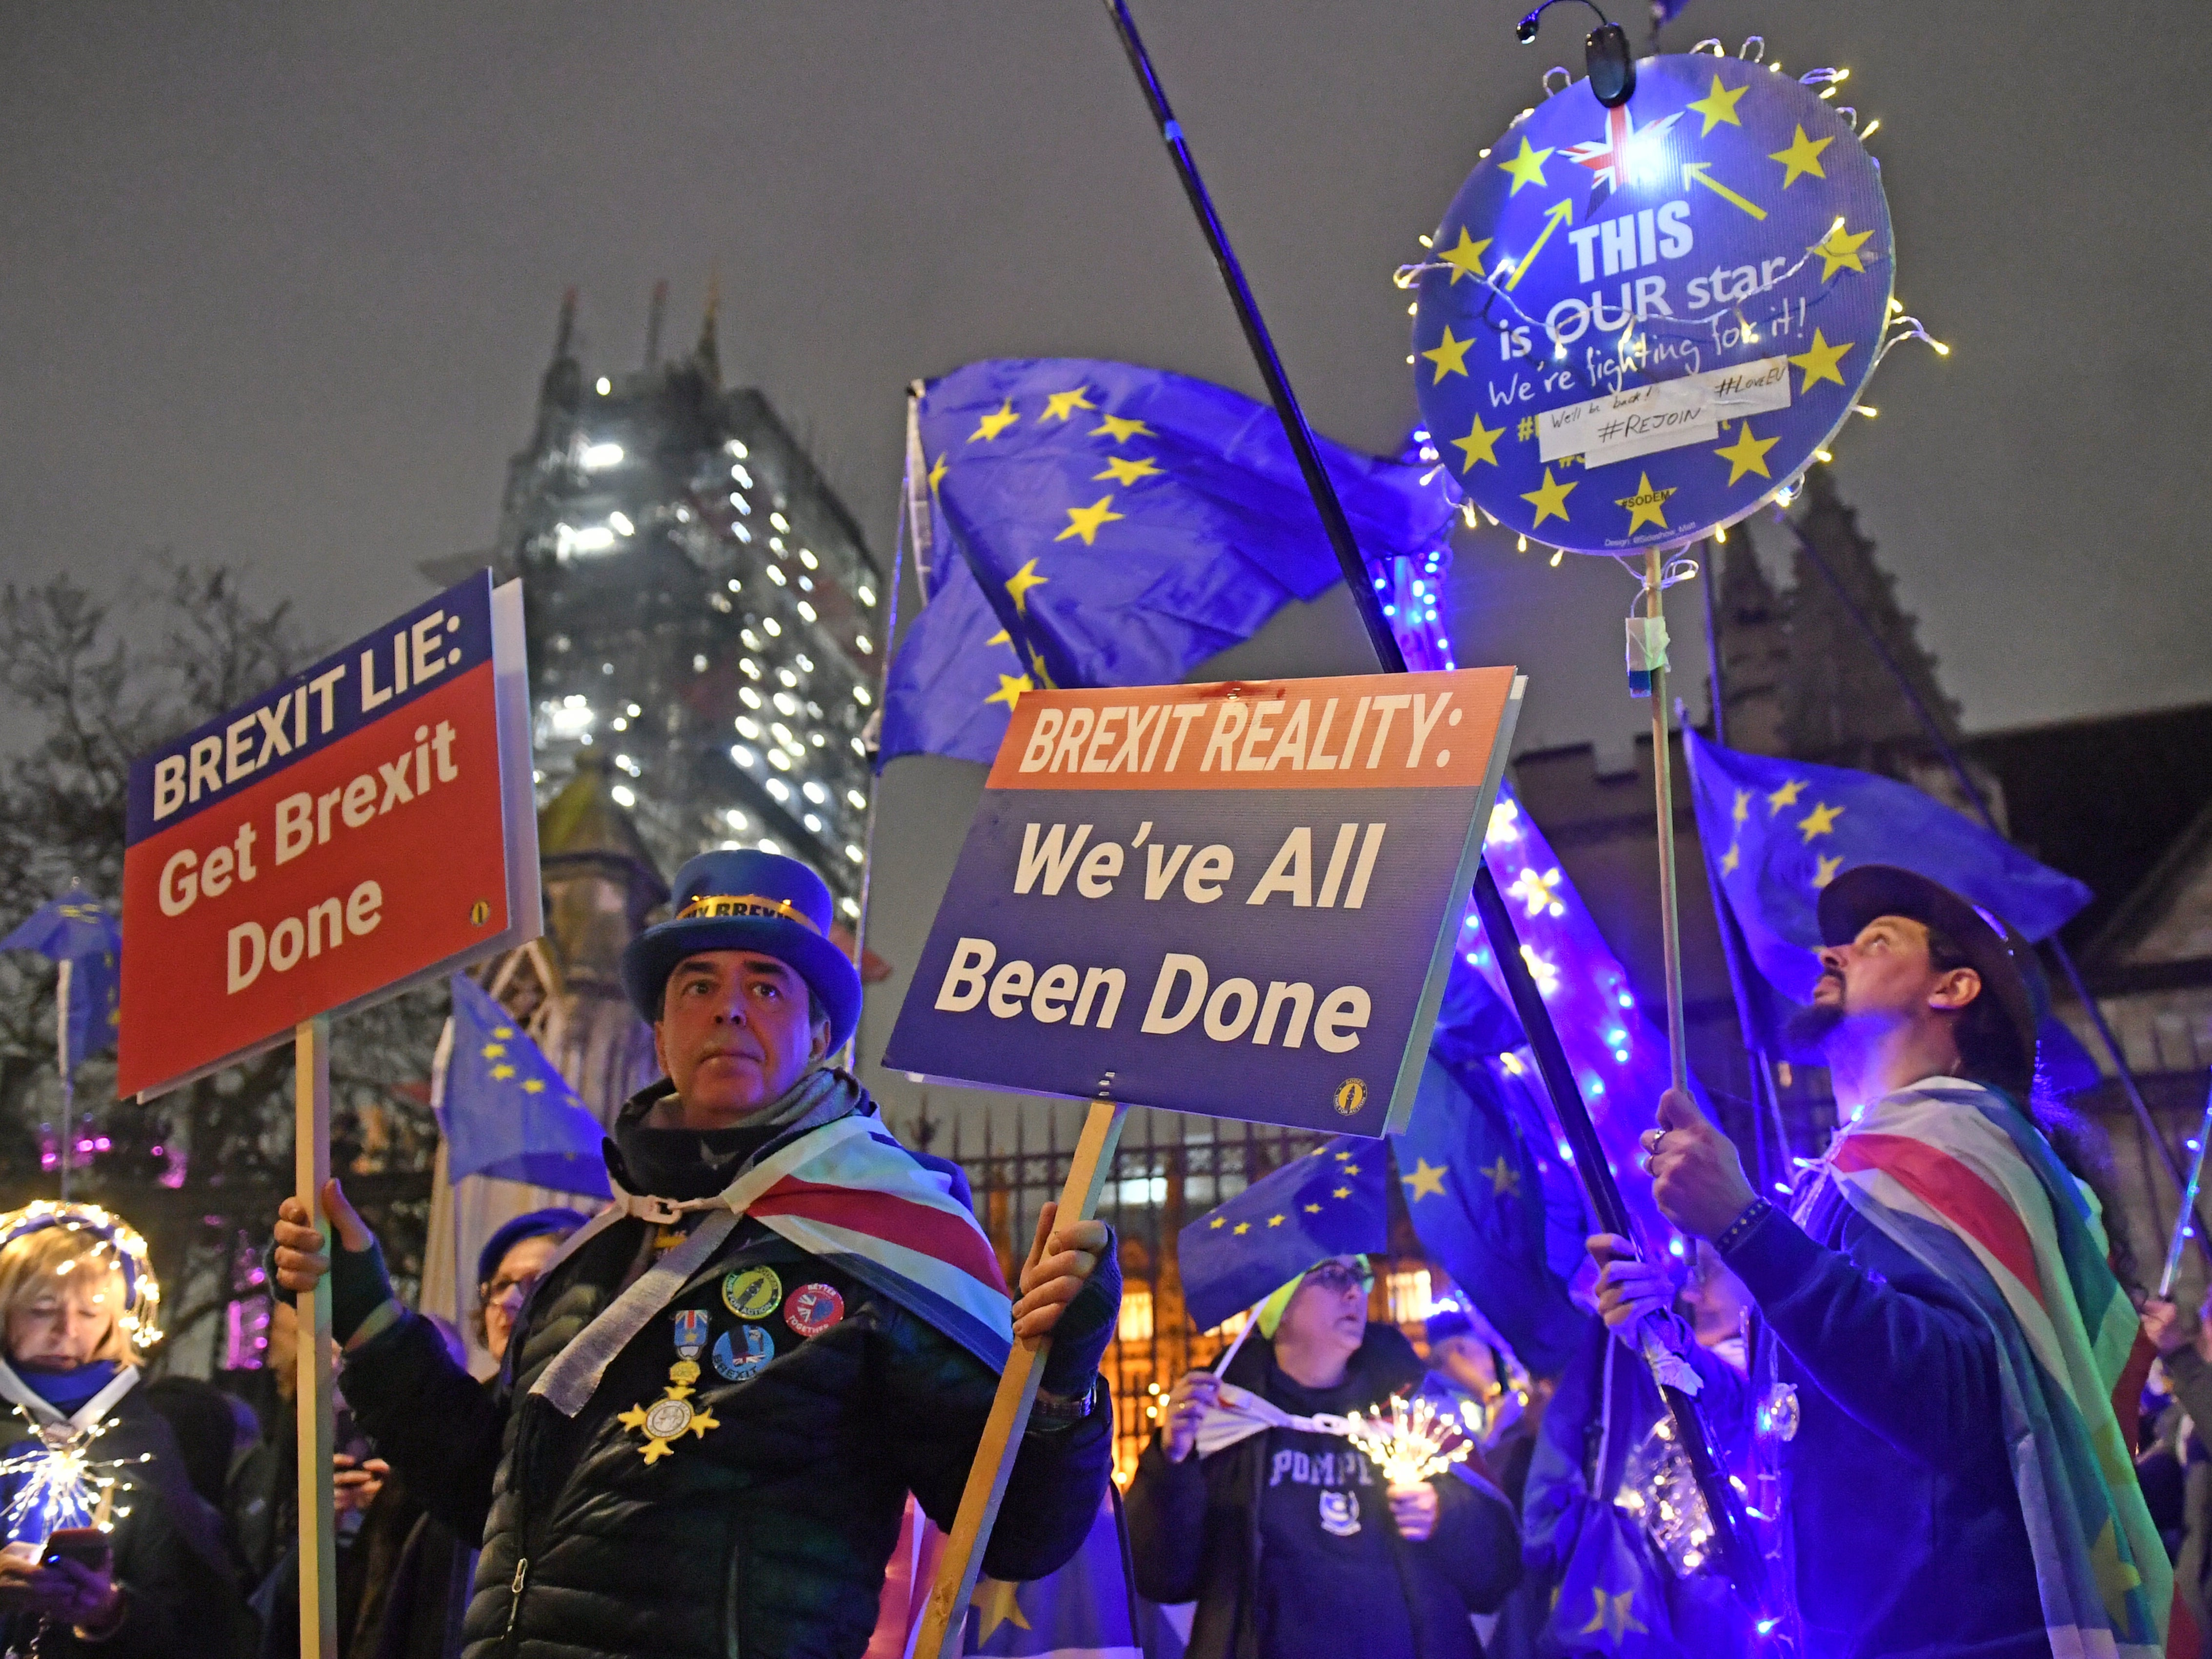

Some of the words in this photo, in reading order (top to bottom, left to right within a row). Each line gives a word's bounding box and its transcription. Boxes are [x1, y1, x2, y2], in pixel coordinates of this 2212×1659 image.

[1568, 200, 1694, 284] THIS
[1499, 319, 1532, 360] is
[1545, 275, 1673, 344] OUR
[1687, 256, 1787, 309] star
[1488, 360, 1575, 408] We're
[1586, 332, 1701, 393] fighting
[1712, 314, 1757, 356] for
[1770, 297, 1806, 337] it!
[1589, 402, 1600, 414] be
[1597, 407, 1702, 443] #REJOIN
[1622, 490, 1670, 508] #SODEM
[153, 665, 346, 821] BREXIT
[360, 610, 463, 713] LIE:
[1018, 703, 1207, 773] BREXIT
[1200, 692, 1463, 772] REALITY:
[158, 822, 256, 918] Get
[275, 720, 459, 866] Brexit
[1013, 820, 1235, 902] We've
[1247, 822, 1387, 909] All
[227, 880, 383, 996] Done
[934, 937, 1126, 1029] Been
[1140, 953, 1372, 1054] Done
[741, 1302, 772, 1316] ACTION
[807, 1282, 837, 1297] BETTER
[712, 1354, 757, 1378] BREXIT
